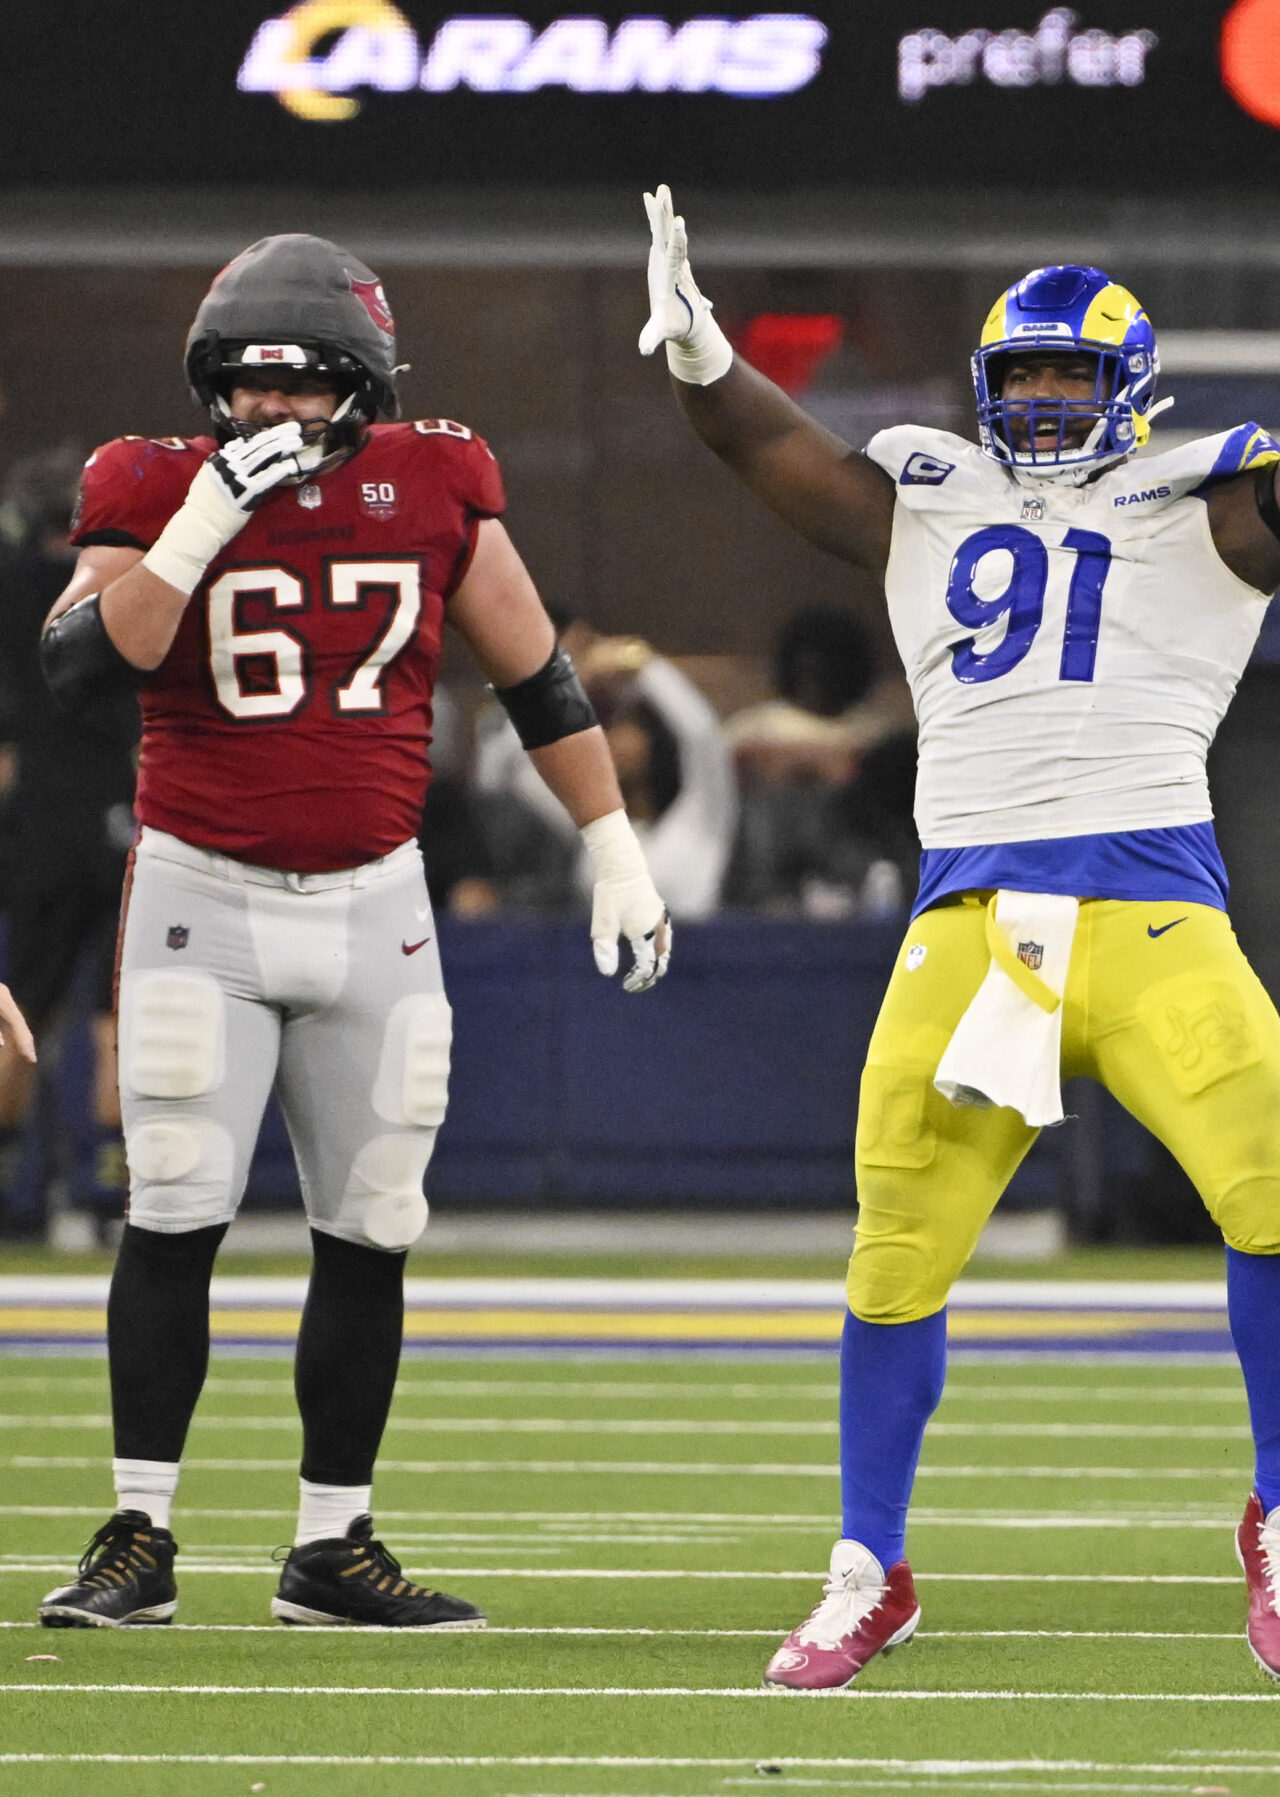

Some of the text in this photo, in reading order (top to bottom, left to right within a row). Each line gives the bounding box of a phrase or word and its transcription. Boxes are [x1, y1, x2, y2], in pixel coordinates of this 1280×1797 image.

[419, 14, 828, 98] RAMS
[898, 7, 1159, 104] prefer
[361, 482, 396, 503] 50
[1114, 485, 1171, 507] RAMS
[206, 556, 424, 722] 67
[945, 523, 1112, 684] 91
